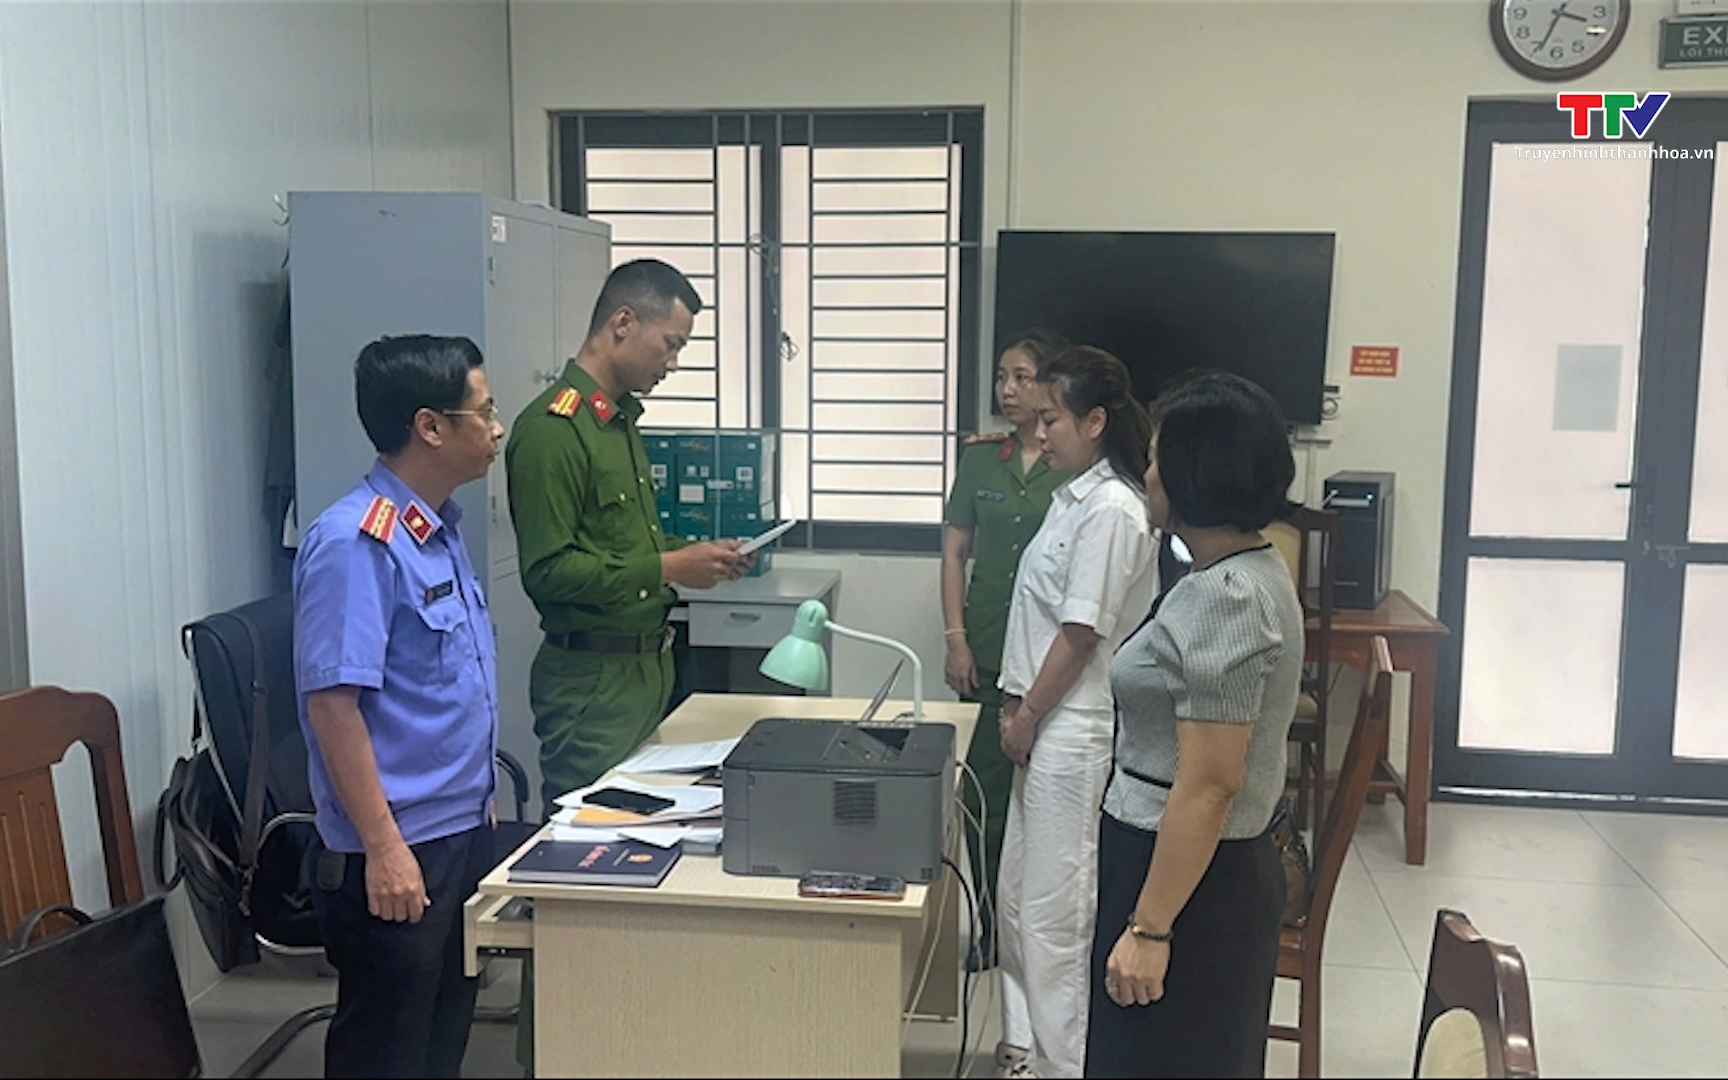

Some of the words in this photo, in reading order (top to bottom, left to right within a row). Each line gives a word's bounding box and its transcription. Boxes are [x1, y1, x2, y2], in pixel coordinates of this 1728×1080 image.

[1513, 7, 1527, 20] 9
[1593, 6, 1607, 18] 3
[1516, 26, 1530, 39] 8
[1531, 41, 1543, 57] 7
[1550, 46, 1563, 59] 6
[1571, 40, 1584, 53] 5
